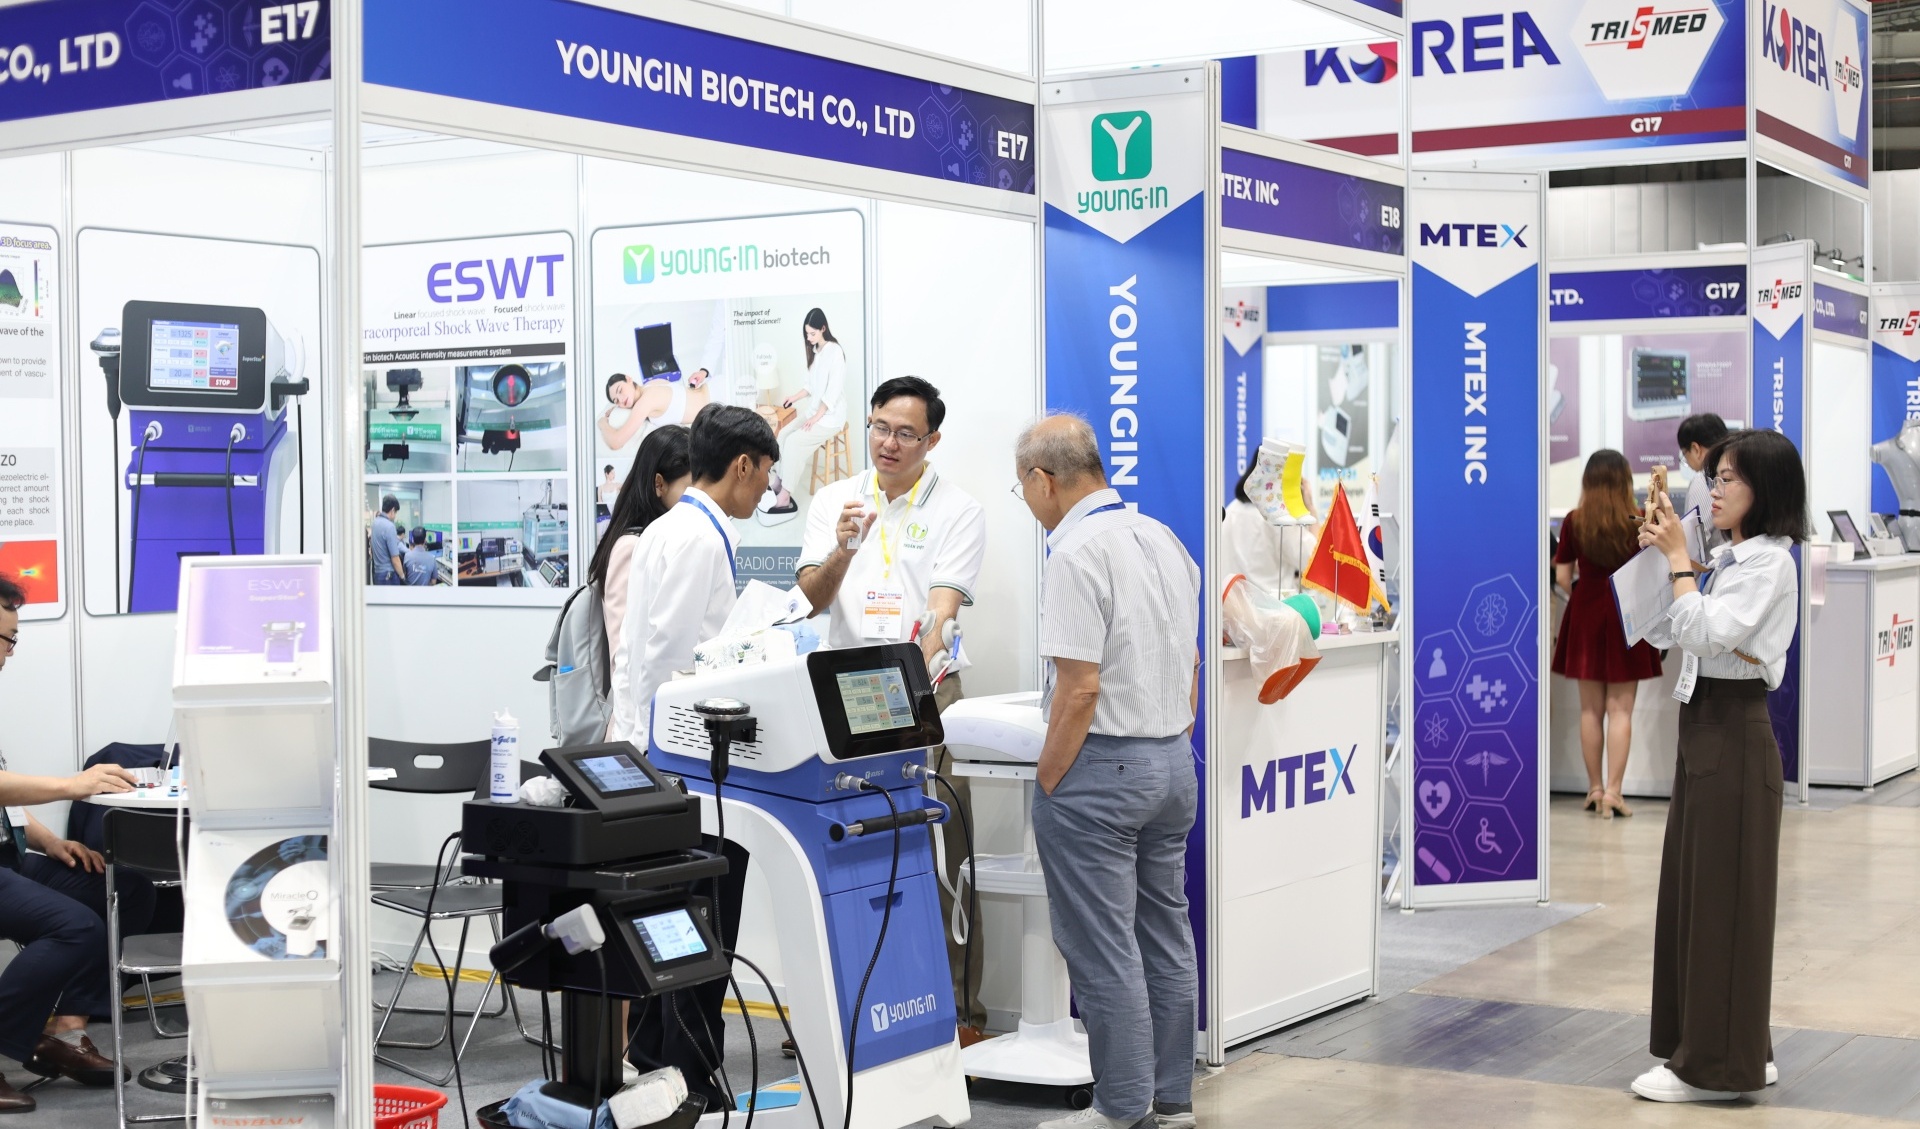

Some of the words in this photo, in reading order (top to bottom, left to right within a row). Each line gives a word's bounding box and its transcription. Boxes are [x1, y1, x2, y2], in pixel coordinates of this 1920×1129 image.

[59, 31, 121, 73] LTD
[260, 0, 320, 44] E17
[1590, 10, 1708, 46] TRISMED
[1762, 0, 1830, 91] KOREA
[555, 39, 693, 98] YOUNGIN
[700, 72, 815, 121] BIOTECH
[821, 93, 869, 137] CO.,
[874, 106, 916, 139] LTD
[1630, 116, 1662, 134] G17
[997, 129, 1029, 161] E17
[1255, 179, 1280, 206] INC
[1381, 205, 1401, 229] E18
[1, 236, 13, 247] 3D
[13, 237, 33, 249] focus
[33, 241, 51, 251] area.
[1420, 223, 1528, 248] MTEX
[763, 246, 831, 268] biotech
[427, 254, 564, 303] ESWT
[1705, 282, 1741, 300] G17
[1758, 282, 1802, 306] TRISMED
[394, 311, 417, 319] Linear
[494, 305, 523, 314] Focused
[744, 309, 763, 318] impact
[764, 308, 771, 317] of
[20, 326, 29, 336] of
[30, 327, 44, 337] the
[434, 319, 472, 336] Shock
[475, 317, 510, 334] Wave
[513, 315, 566, 335] Therapy
[13, 356, 20, 365] to
[21, 357, 47, 366] provide
[372, 351, 394, 362] biotech
[394, 350, 420, 361] Acoustic
[420, 349, 447, 361] intensity
[447, 348, 489, 359] measurement
[489, 347, 512, 358] system
[14, 369, 22, 377] of
[1109, 273, 1138, 486] YOUNGIN
[1464, 322, 1487, 417] MTEX
[215, 379, 231, 387] STOP
[1464, 426, 1488, 485] INC
[12, 495, 24, 504] the
[28, 495, 50, 504] shock
[23, 485, 50, 493] amount
[6, 507, 24, 515] each
[29, 506, 50, 515] shock
[14, 518, 35, 528] place.
[735, 556, 775, 571] RADIO
[247, 578, 305, 591] ESWT
[1878, 624, 1914, 656] TRISMED
[1241, 743, 1358, 819] MTEX
